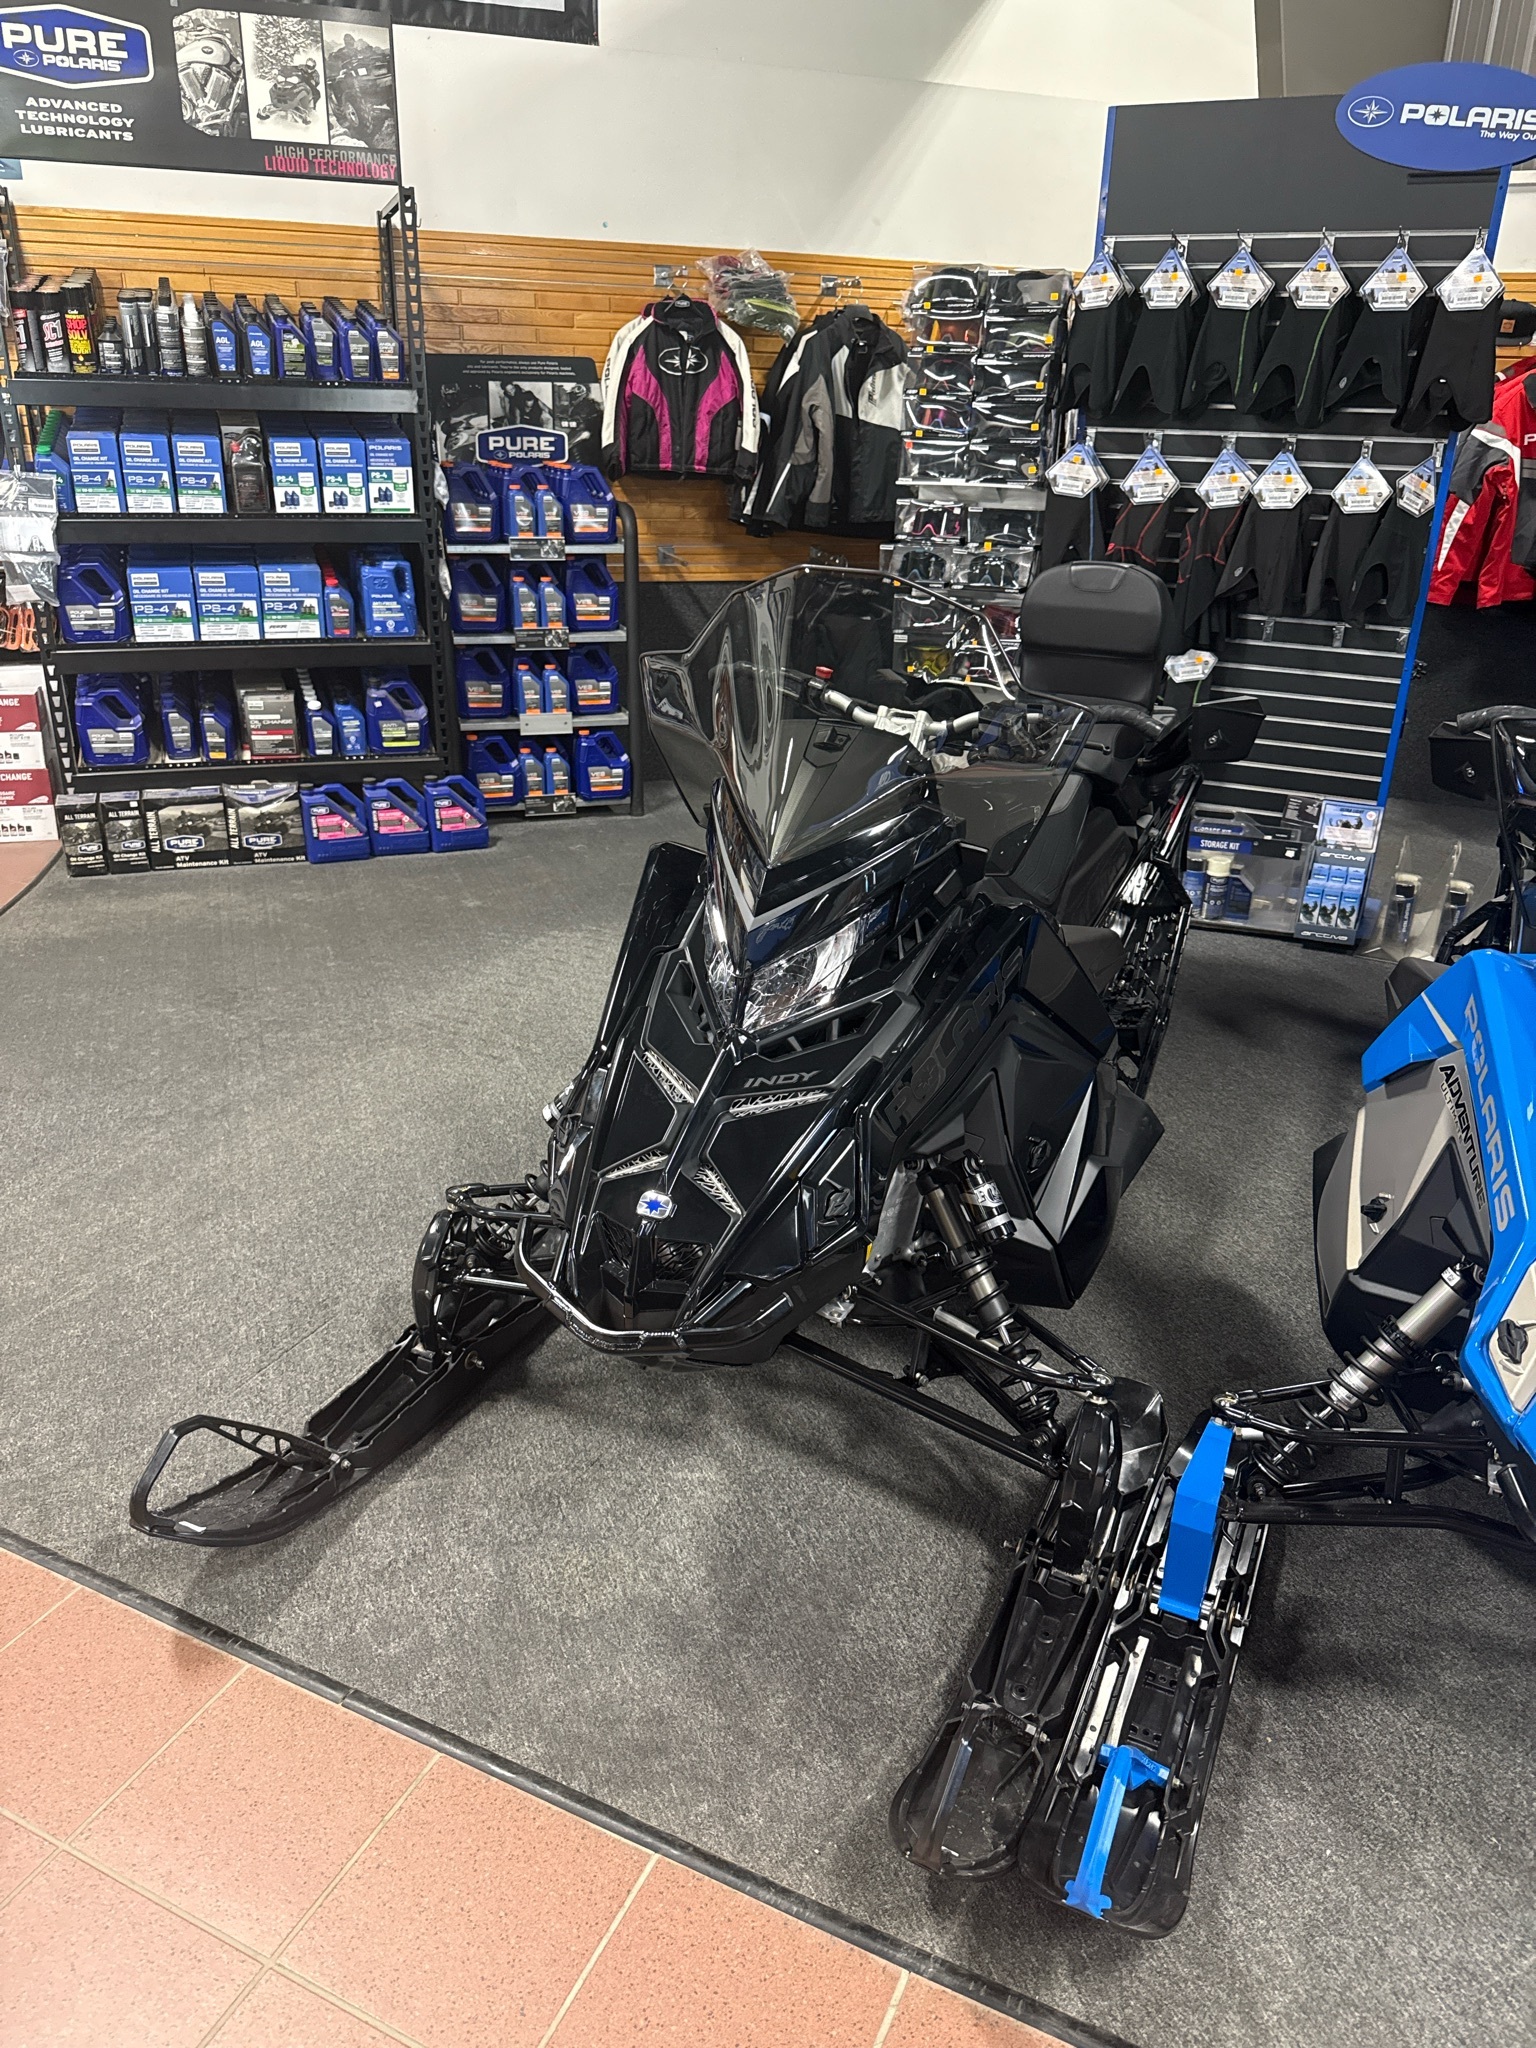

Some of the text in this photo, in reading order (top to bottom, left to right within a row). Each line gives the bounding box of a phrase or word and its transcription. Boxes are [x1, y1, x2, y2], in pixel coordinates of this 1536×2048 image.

[1, 22, 128, 59] PURE
[42, 53, 122, 72] POLARIS
[25, 96, 122, 113] ADVANCED
[15, 109, 135, 128] TECHNOLOGY
[20, 123, 134, 141] LUBRICANTS
[1480, 129, 1496, 139] The
[1499, 131, 1520, 142] Way
[274, 145, 397, 167] HIGH PERFORMANCE
[264, 155, 397, 179] LIQUID TECHNOLOGY
[66, 318, 87, 329] SHOP
[216, 336, 230, 344] AGL
[250, 340, 266, 348] AGL
[488, 436, 556, 451] PURE
[134, 605, 170, 613] PS-4
[202, 604, 236, 613] PS-4
[264, 602, 298, 611] PS-4
[0, 772, 32, 781] CHANGE
[146, 811, 161, 853] ALL TERRAIN
[227, 808, 240, 849] ALL TERRAIN
[170, 838, 200, 846] PURE
[1200, 840, 1240, 850] STORAGE KIT
[744, 1070, 823, 1089] INDY
[1464, 993, 1515, 1232] POLARIS
[1438, 1063, 1486, 1211] ADVENTURE
